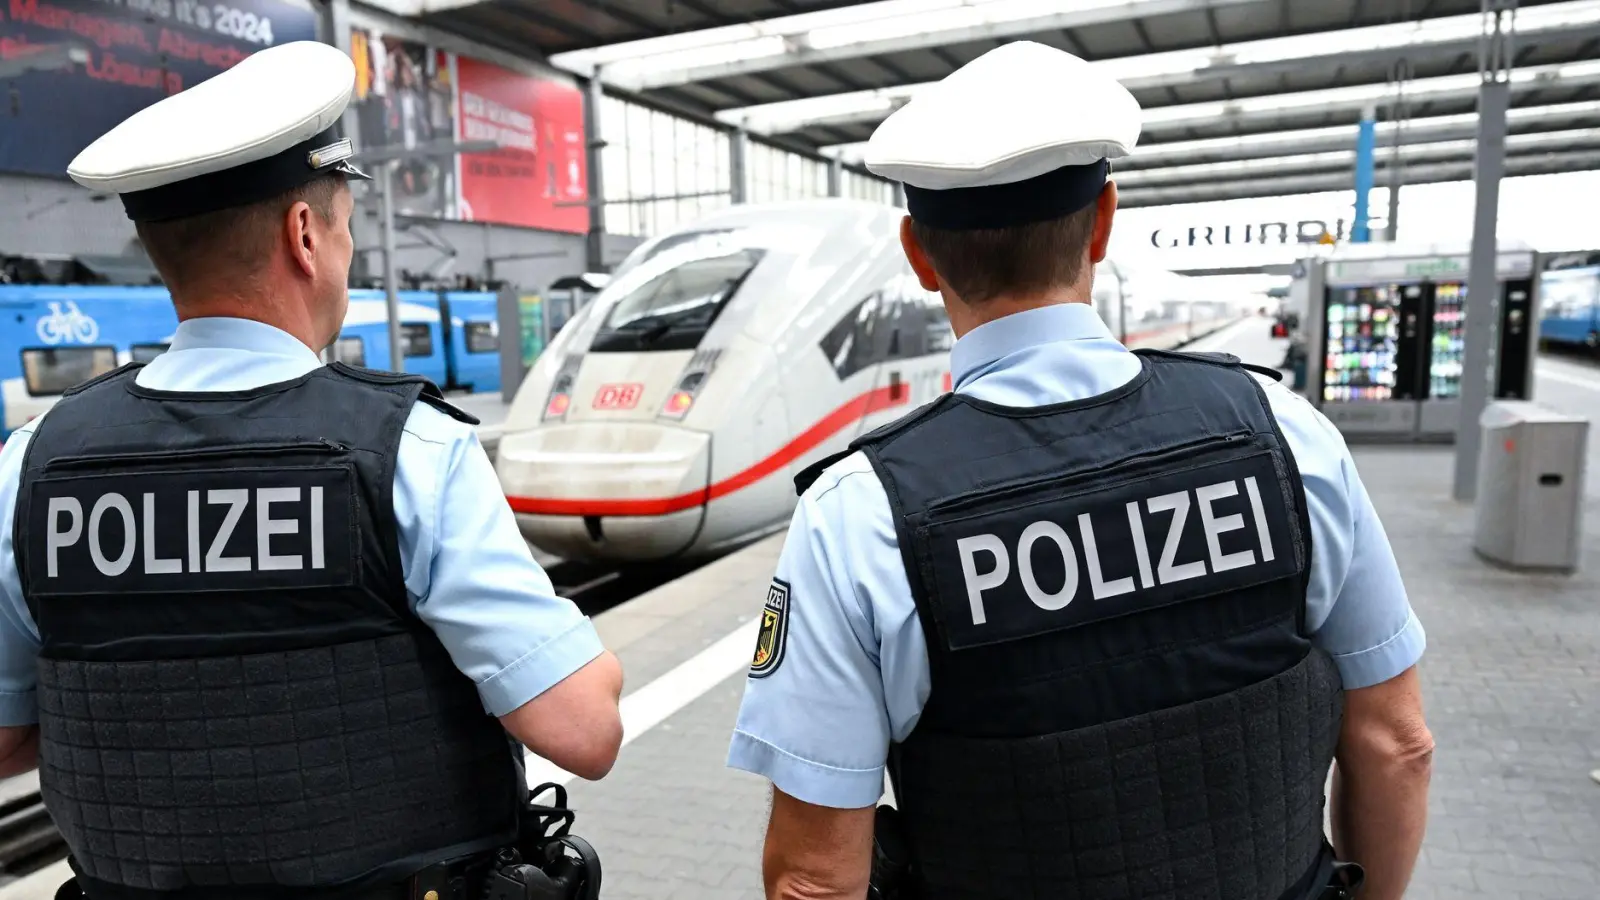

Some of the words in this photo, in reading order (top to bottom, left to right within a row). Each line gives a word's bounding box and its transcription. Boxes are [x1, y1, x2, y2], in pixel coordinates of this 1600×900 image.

[213, 4, 275, 46] 2024
[596, 386, 640, 408] DB
[47, 486, 325, 577] POLIZEI
[957, 476, 1275, 626] POLIZEI
